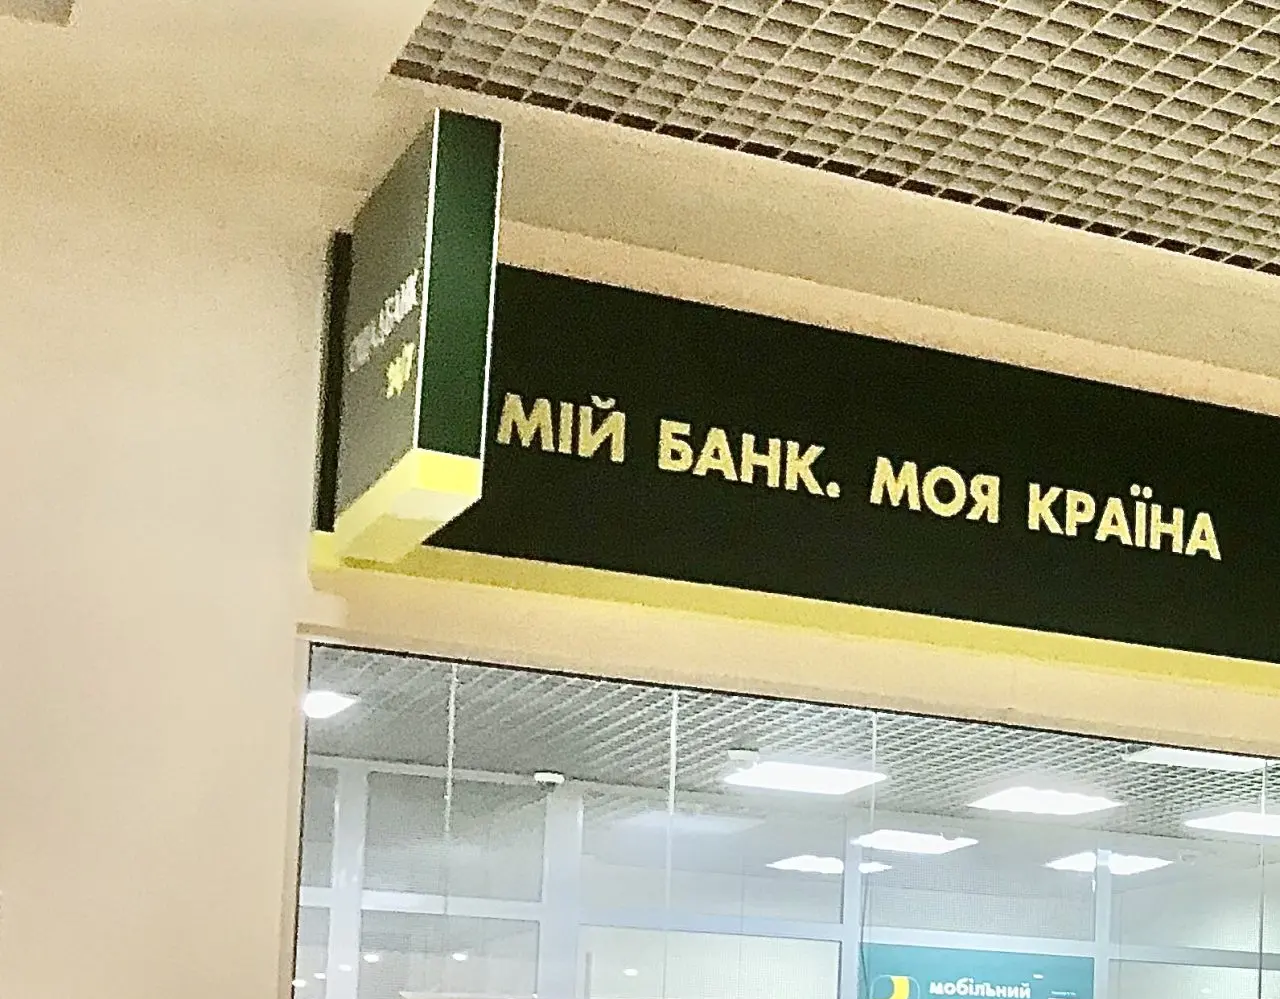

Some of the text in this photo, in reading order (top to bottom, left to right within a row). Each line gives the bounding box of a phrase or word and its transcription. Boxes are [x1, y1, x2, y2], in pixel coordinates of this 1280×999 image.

[496, 391, 1222, 561] МІЙ БАНК. МОЯ КРАЇНА
[928, 976, 1032, 999] мобільний
